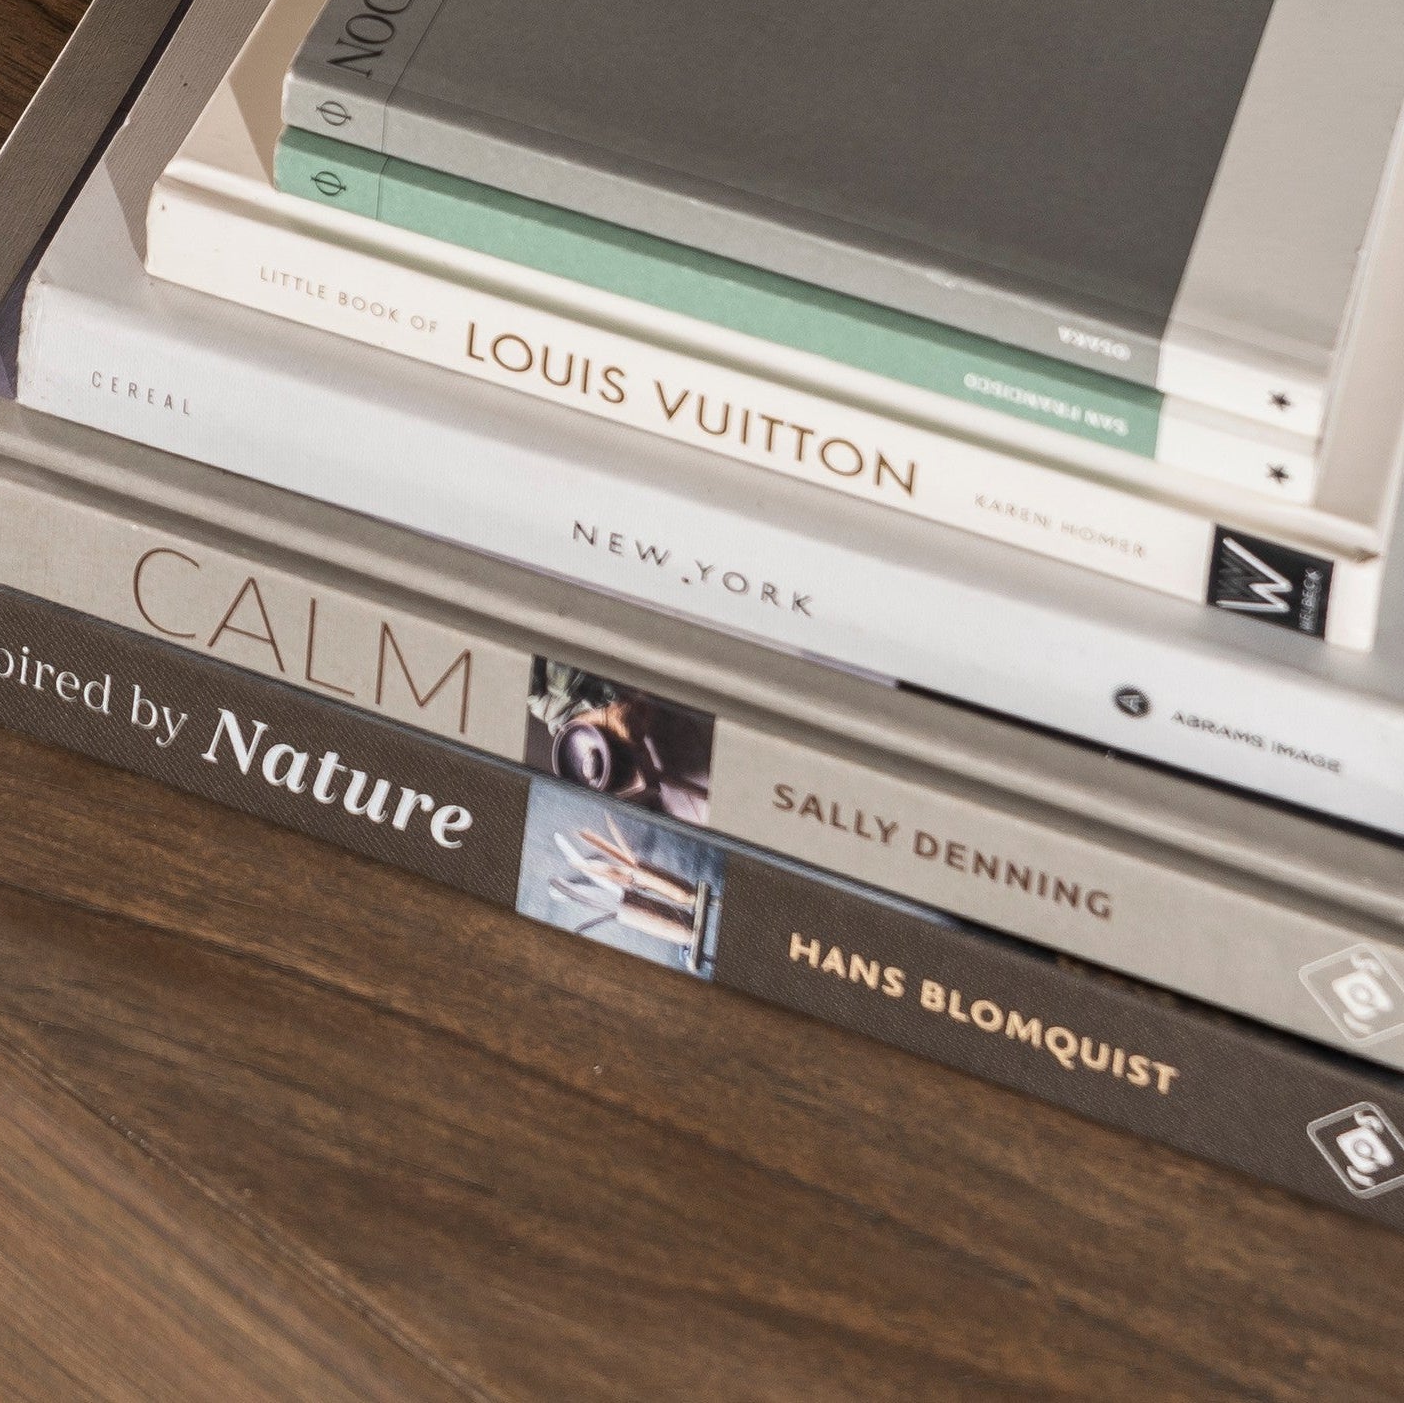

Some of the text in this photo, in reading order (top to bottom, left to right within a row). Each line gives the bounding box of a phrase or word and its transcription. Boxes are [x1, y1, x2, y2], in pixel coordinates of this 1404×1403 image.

[260, 266, 438, 333] LITTLE BOOK OF
[91, 371, 190, 416] CEREAL
[465, 321, 916, 495] LOUIS VUITTON
[572, 520, 670, 566] NEW
[973, 492, 1145, 559] KAREN HOMER
[132, 546, 474, 735] CALM
[131, 684, 189, 747] by
[200, 707, 475, 850] Nature
[1171, 710, 1342, 774] ABRAMS IMAGE
[772, 782, 1114, 922] SALLY DENNING
[788, 931, 1181, 1095] HANS BLOMQUIST
